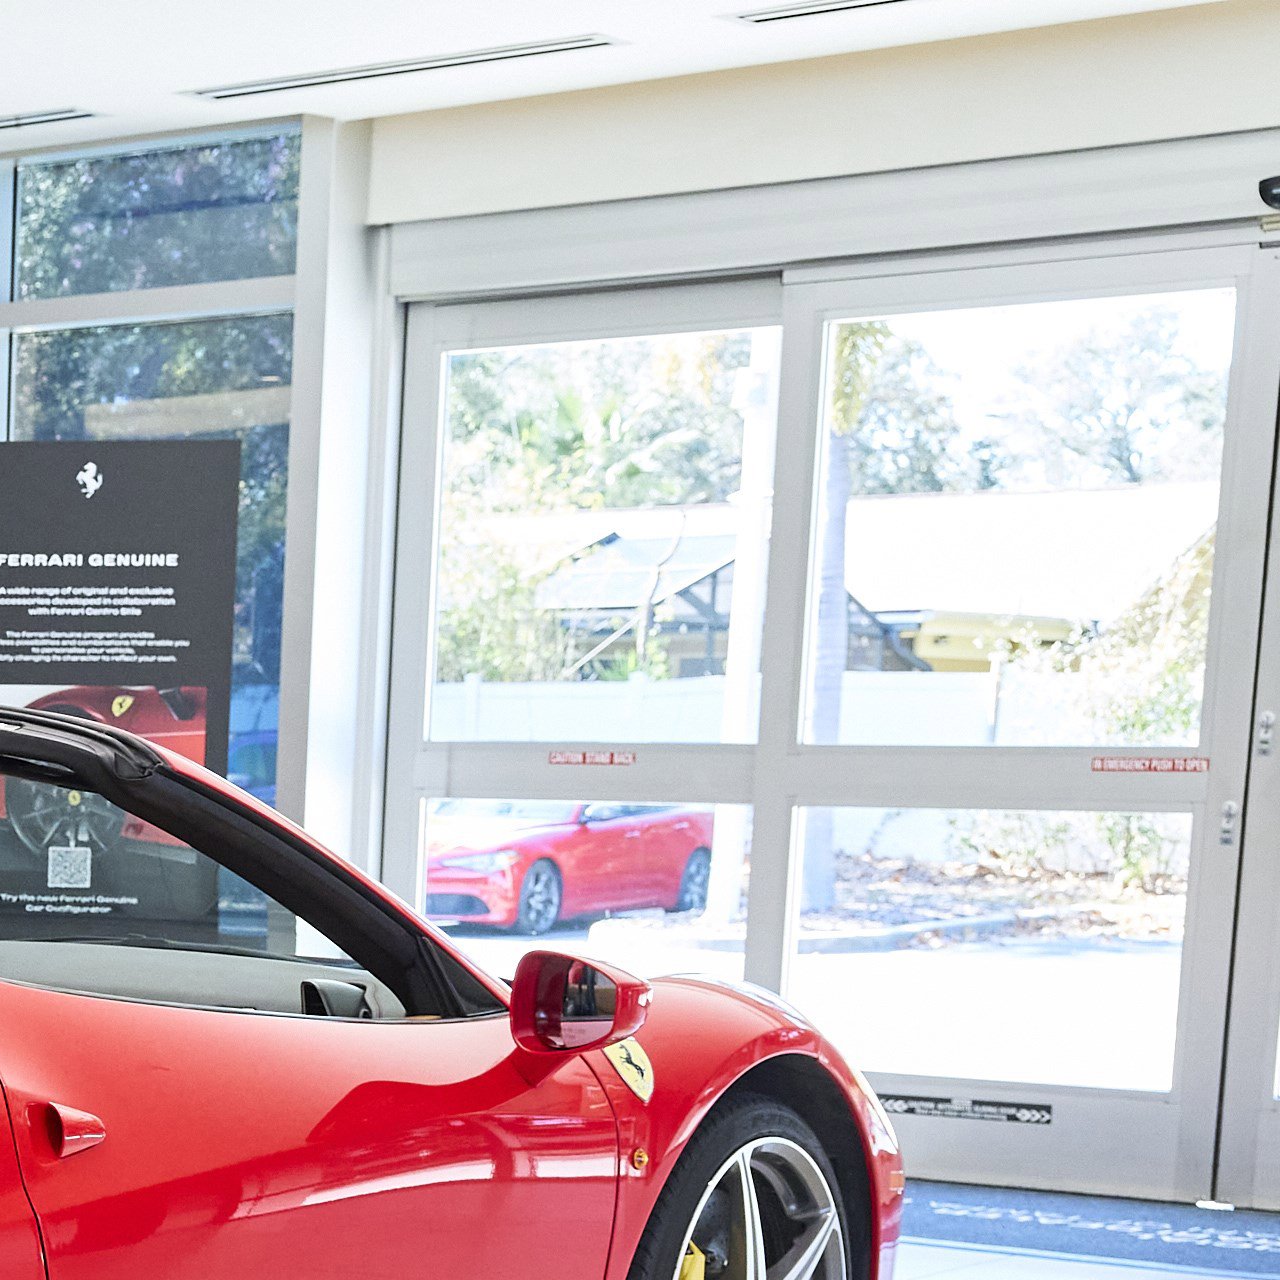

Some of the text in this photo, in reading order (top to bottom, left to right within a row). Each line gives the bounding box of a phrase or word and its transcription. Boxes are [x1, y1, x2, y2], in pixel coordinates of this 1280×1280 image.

[88, 554, 179, 566] GENUINE
[7, 586, 30, 596] wide
[31, 586, 60, 596] range
[61, 586, 72, 596] of
[72, 586, 109, 596] original
[109, 586, 128, 596] and
[128, 586, 174, 596] exclusive
[50, 607, 85, 616] Ferrari
[549, 752, 582, 764] CAUTION
[1103, 758, 1149, 771] EMERGENCY
[1150, 758, 1173, 771] PUSH
[1174, 759, 1185, 771] TO
[1186, 759, 1208, 772] OPEN
[0, 893, 138, 904] Try the new Ferrari Genuine
[25, 904, 112, 914] Car Configurator
